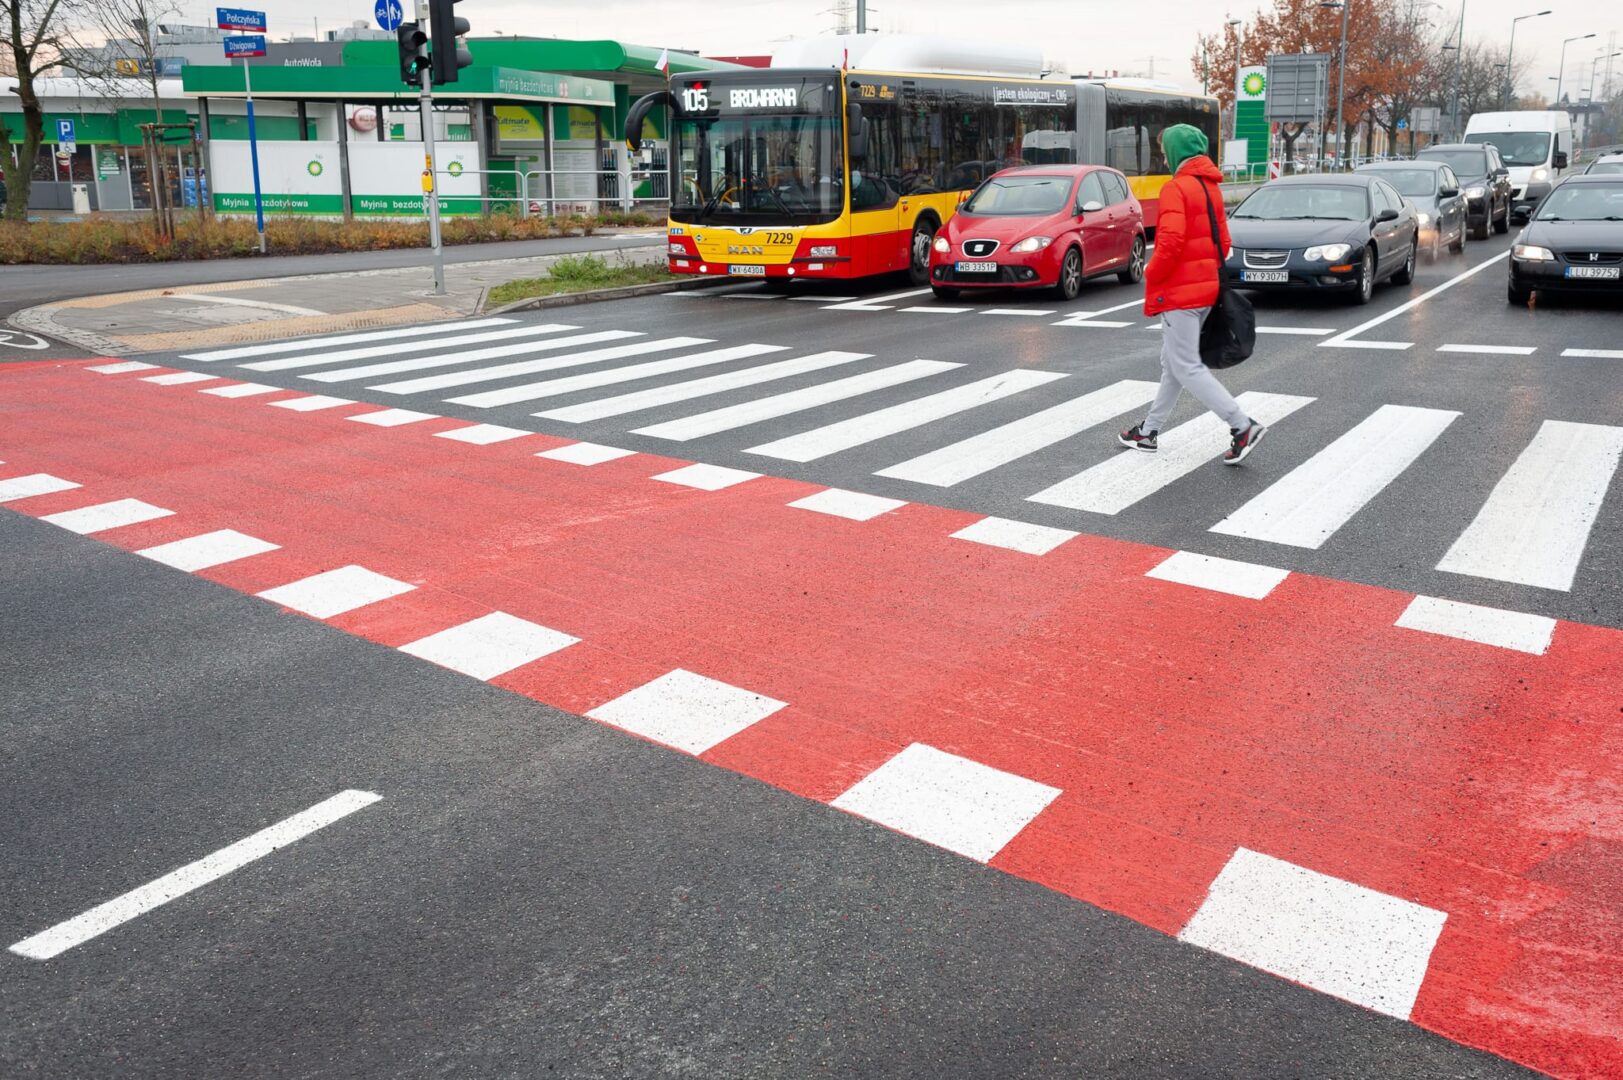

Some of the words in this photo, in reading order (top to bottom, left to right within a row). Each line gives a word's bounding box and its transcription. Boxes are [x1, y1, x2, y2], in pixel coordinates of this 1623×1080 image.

[682, 89, 708, 111] 105
[730, 88, 797, 108] BROWARNA
[60, 121, 71, 136] P
[222, 198, 249, 208] Myjnia
[361, 200, 388, 210] Myjnia
[766, 232, 794, 245] 7229
[728, 246, 763, 256] MAN
[960, 262, 970, 271] WB
[1246, 272, 1257, 281] WY
[1260, 272, 1287, 281] 9307H
[1590, 268, 1619, 278] 39752
